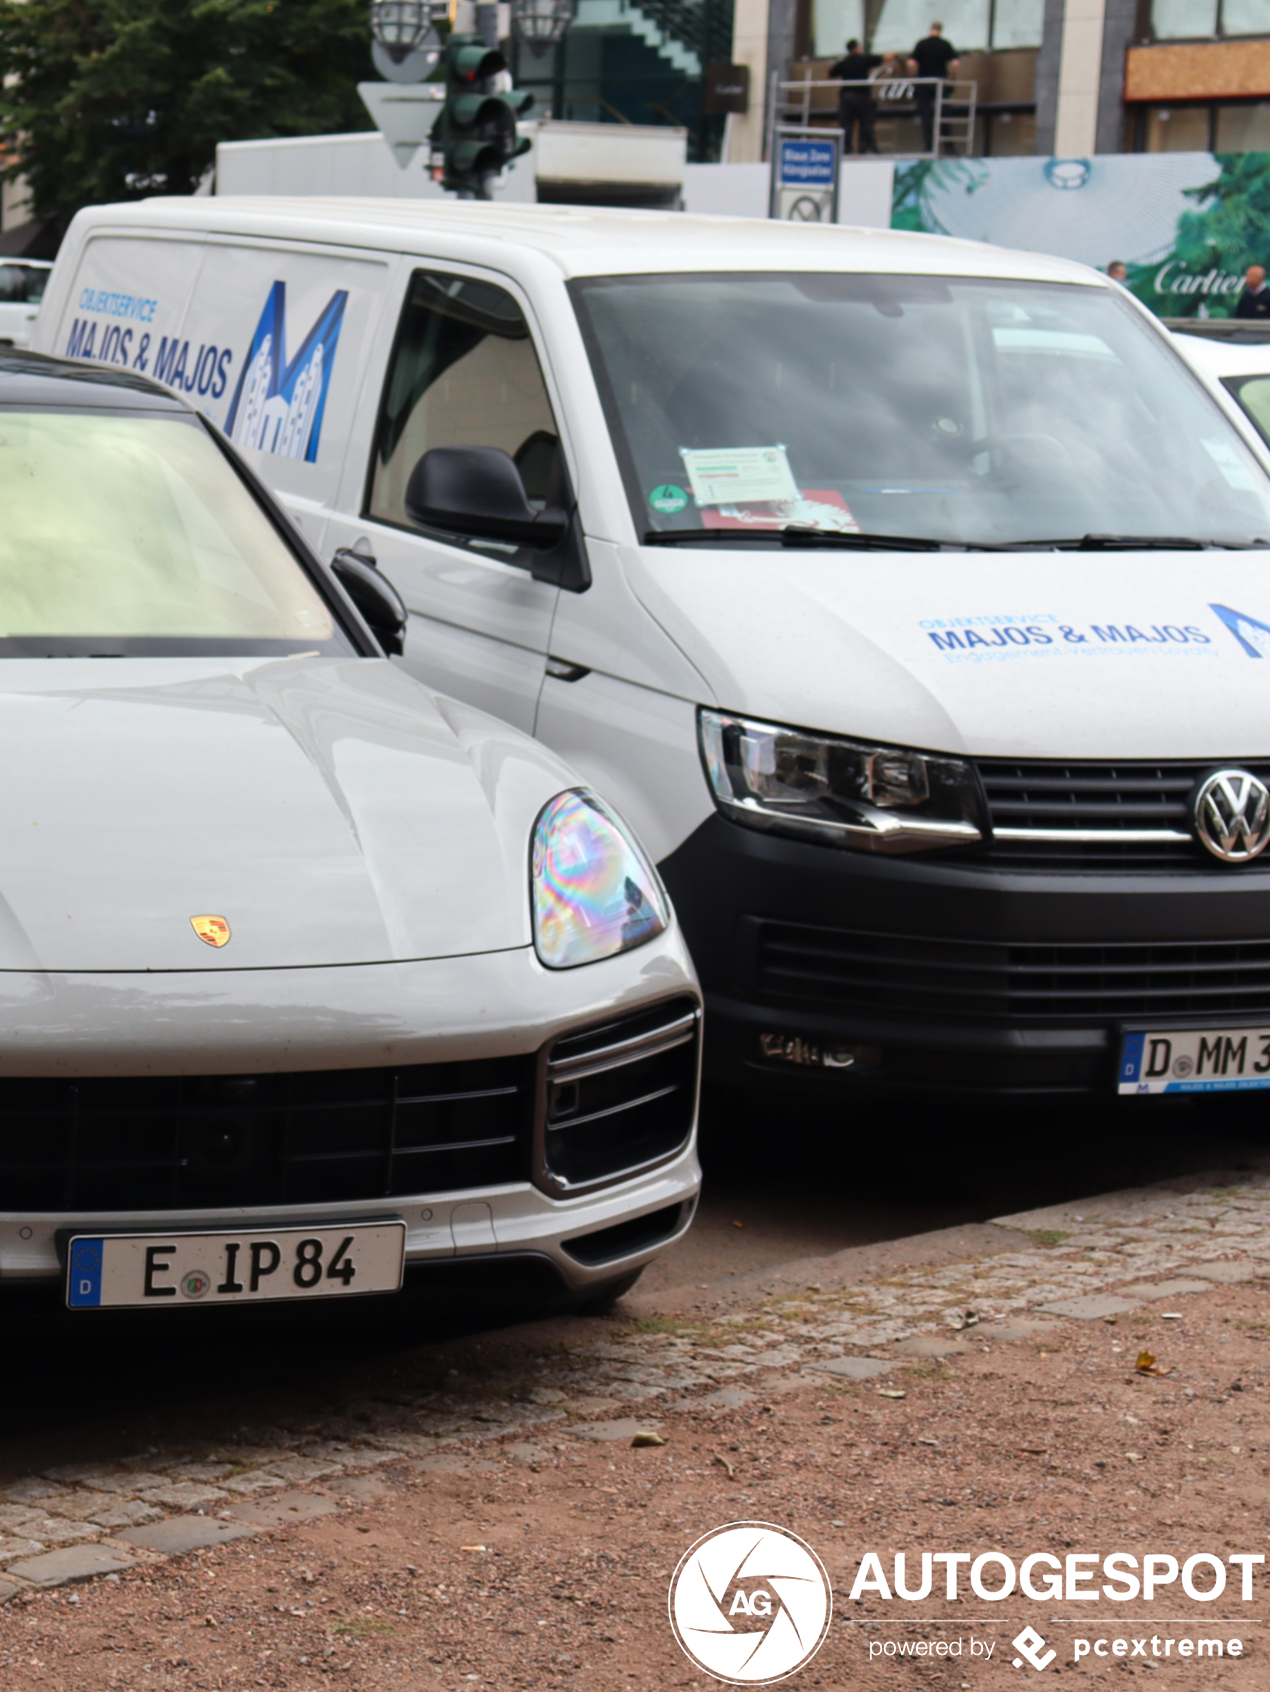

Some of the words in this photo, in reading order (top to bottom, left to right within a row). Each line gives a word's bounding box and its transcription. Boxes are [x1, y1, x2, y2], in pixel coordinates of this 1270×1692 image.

[79, 288, 158, 322] OBJEKTSERVICE
[132, 332, 151, 372] &
[153, 336, 232, 400] MAJOS
[918, 614, 1059, 630] OBJEKTSERVICE
[927, 626, 1053, 651] MAJOS
[1058, 625, 1090, 643] &
[1090, 625, 1212, 644] MAJOS
[1124, 1063, 1134, 1076] D
[1145, 1038, 1172, 1077] D
[1196, 1035, 1248, 1075] MM
[143, 1244, 177, 1298] E
[217, 1239, 281, 1295] IP
[293, 1236, 356, 1290] 84
[79, 1280, 91, 1295] D
